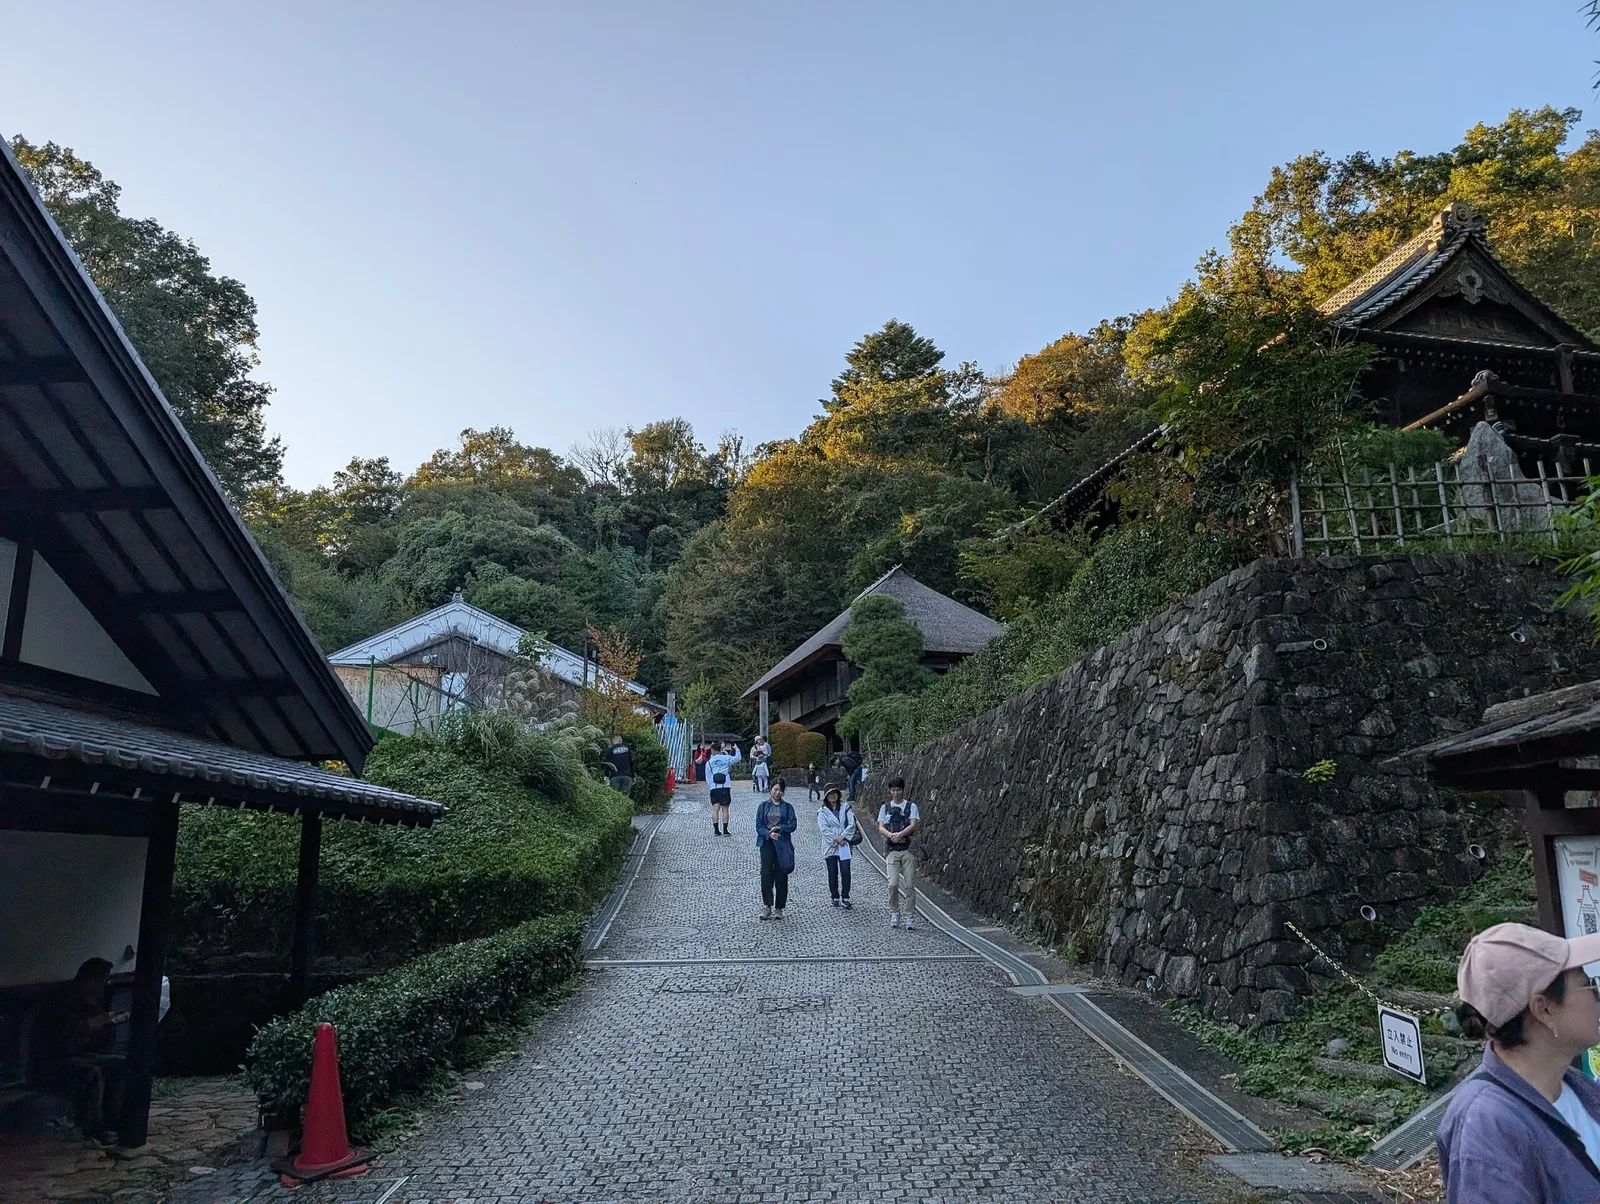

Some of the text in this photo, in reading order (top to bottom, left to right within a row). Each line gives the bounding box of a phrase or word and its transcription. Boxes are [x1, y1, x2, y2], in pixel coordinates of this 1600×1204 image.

[1387, 1028, 1413, 1048] 立入禁止
[1391, 1045, 1413, 1064] No entry
